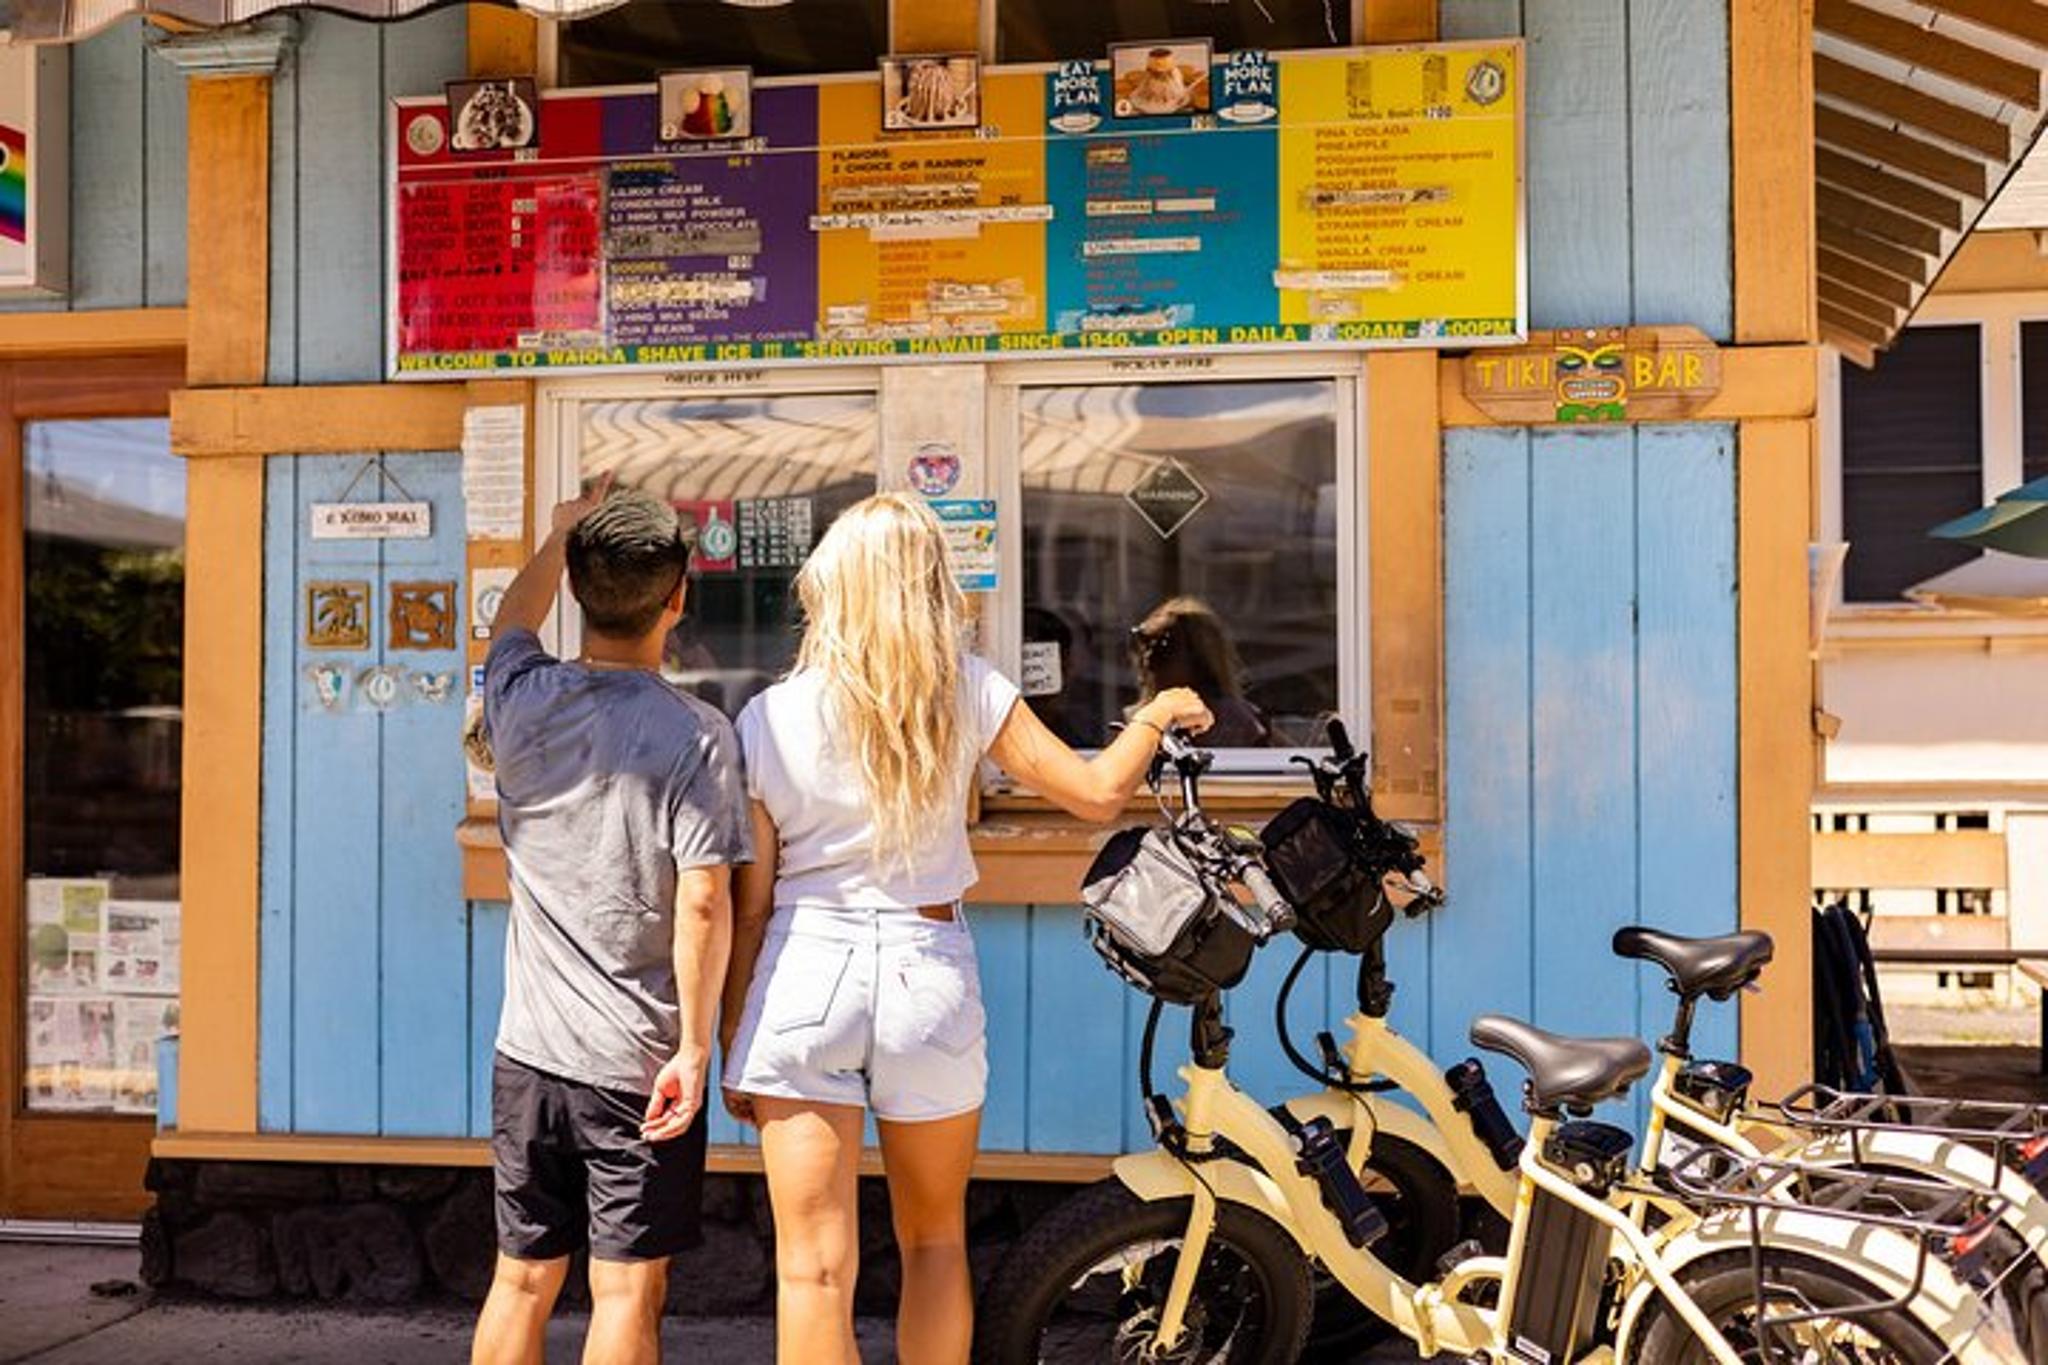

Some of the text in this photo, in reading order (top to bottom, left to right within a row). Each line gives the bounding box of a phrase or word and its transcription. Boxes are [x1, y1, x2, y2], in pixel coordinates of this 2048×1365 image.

[1231, 51, 1264, 66] EAT
[1060, 61, 1093, 77] EAT
[1224, 65, 1272, 82] MORE
[1054, 76, 1098, 93] MORE
[1225, 81, 1272, 96] FLAN
[1055, 89, 1099, 107] FLAN
[1316, 140, 1389, 150] PINEAPPLE
[846, 162, 892, 173] CHOICE
[898, 160, 919, 171] OR
[924, 158, 986, 169] RAINBOW
[1316, 166, 1397, 177] RASPBERRY
[1317, 234, 1371, 244] VANILLA
[1317, 245, 1427, 257] VANILLA CREAM
[401, 352, 494, 370] WELCOME
[510, 352, 536, 366] TO
[549, 346, 627, 365] WAIOLA
[637, 344, 706, 362] SHAVE
[718, 343, 751, 360] ICE
[909, 335, 986, 354] HAWAII
[1000, 332, 1063, 350] SINCE
[1156, 327, 1218, 345] OPEN
[1477, 354, 1702, 389] TIKI BAR
